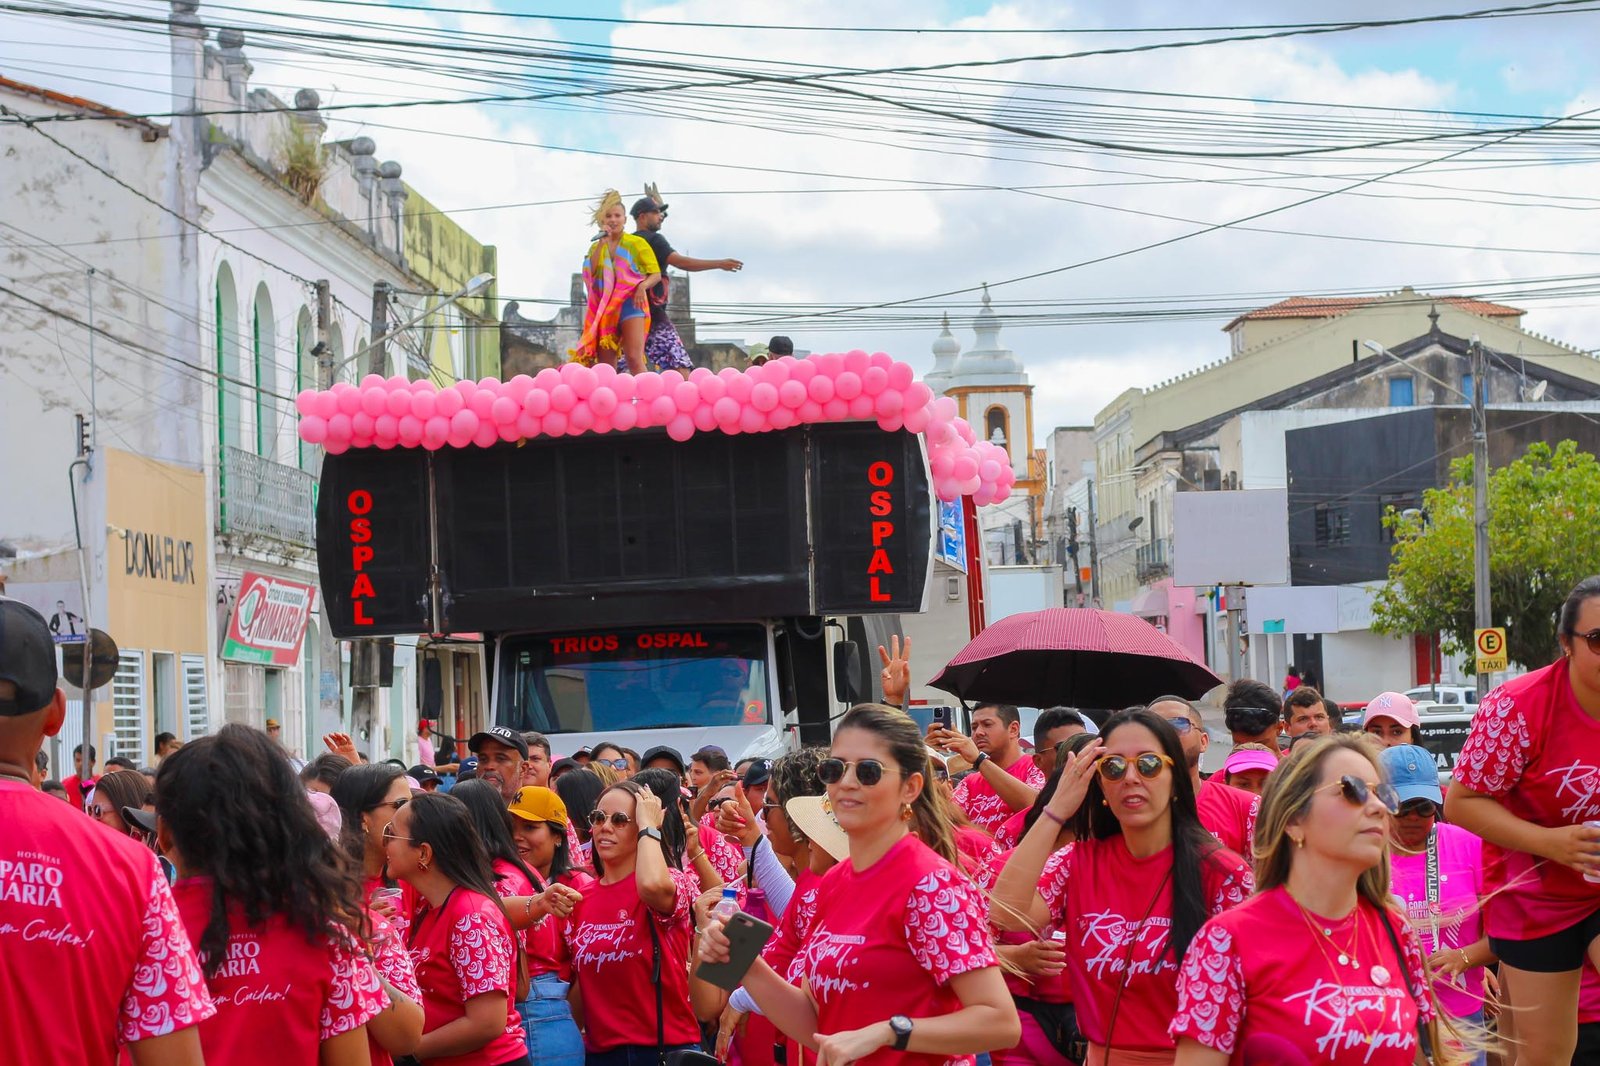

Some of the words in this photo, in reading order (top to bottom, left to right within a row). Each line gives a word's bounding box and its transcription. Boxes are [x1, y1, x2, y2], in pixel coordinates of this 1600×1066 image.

[867, 461, 894, 602] OSPAL
[347, 490, 376, 625] OSPAL
[550, 635, 620, 654] TRIOS
[637, 632, 708, 649] OSPAL
[1486, 635, 1495, 649] E
[1481, 661, 1503, 670] TAXI
[17, 850, 61, 865] HOSPITAL
[1427, 847, 1438, 903] DAMYLLER
[23, 918, 94, 948] Cuidar!
[234, 983, 291, 1006] Cuidar!
[1316, 1018, 1416, 1065] Ampar
